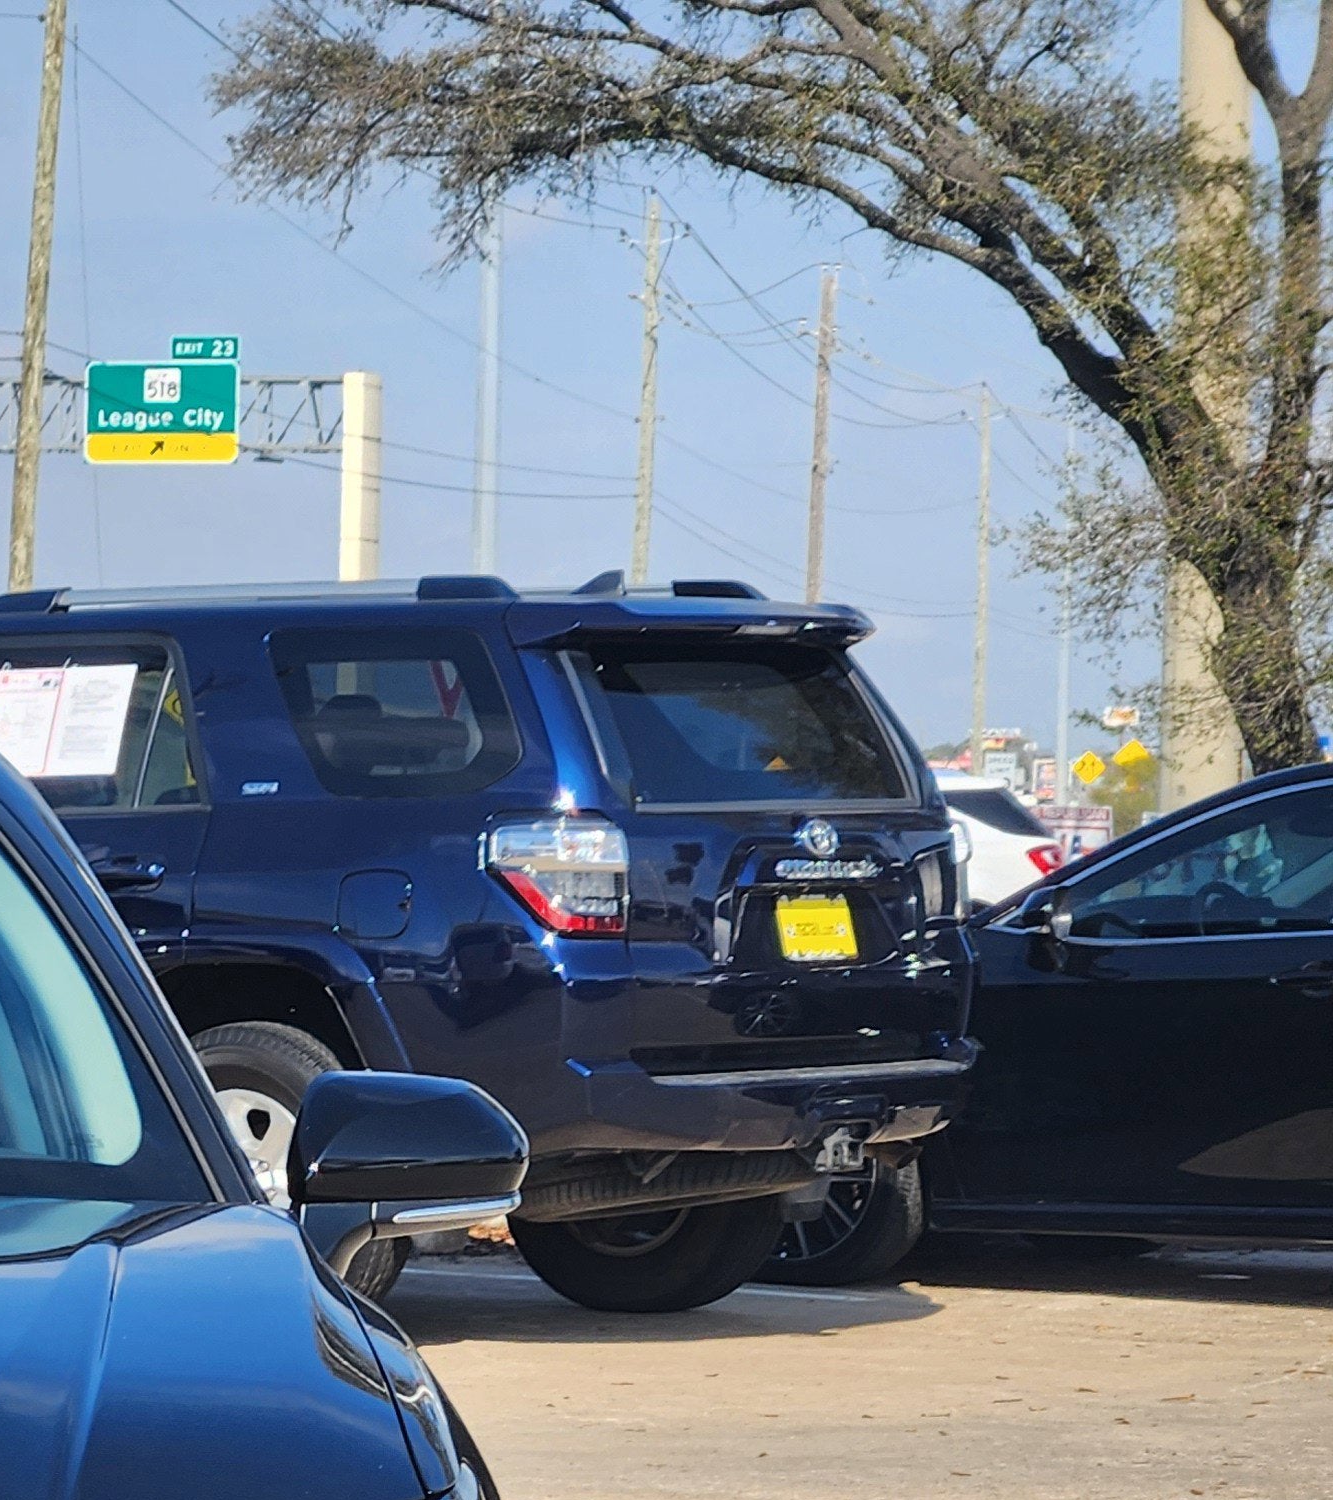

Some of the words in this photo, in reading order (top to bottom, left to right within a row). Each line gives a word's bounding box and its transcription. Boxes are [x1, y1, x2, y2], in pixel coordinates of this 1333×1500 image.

[174, 342, 204, 356] EXIT
[211, 339, 235, 357] 23
[147, 380, 178, 399] 518
[97, 408, 174, 432] League
[183, 407, 225, 432] City
